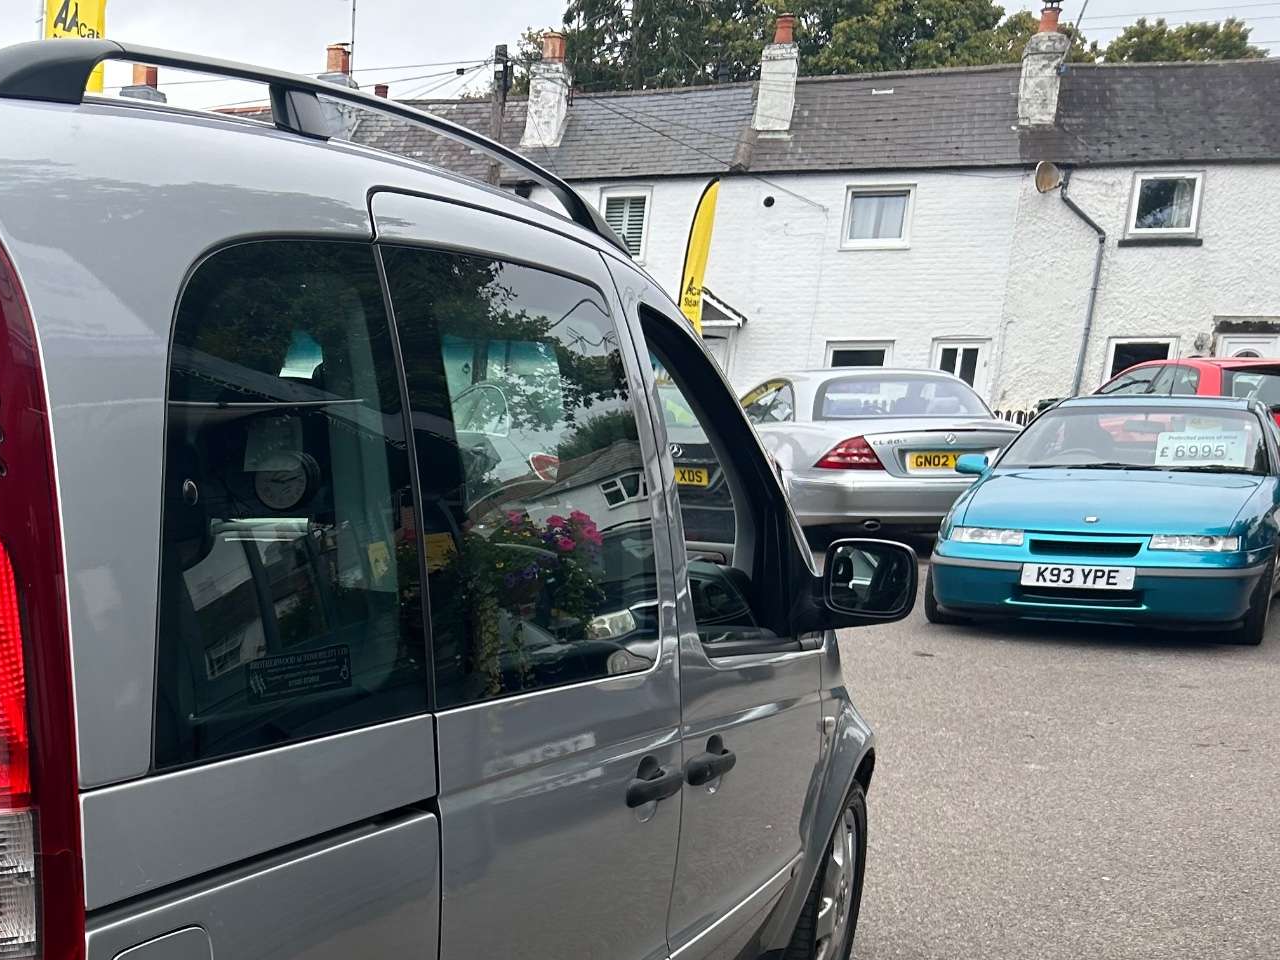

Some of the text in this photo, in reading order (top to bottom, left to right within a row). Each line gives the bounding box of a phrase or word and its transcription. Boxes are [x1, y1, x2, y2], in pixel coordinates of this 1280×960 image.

[1159, 444, 1225, 458] £ 6995
[915, 455, 949, 467] GN02
[680, 470, 703, 483] XDS
[1036, 566, 1120, 586] K93 YPE
